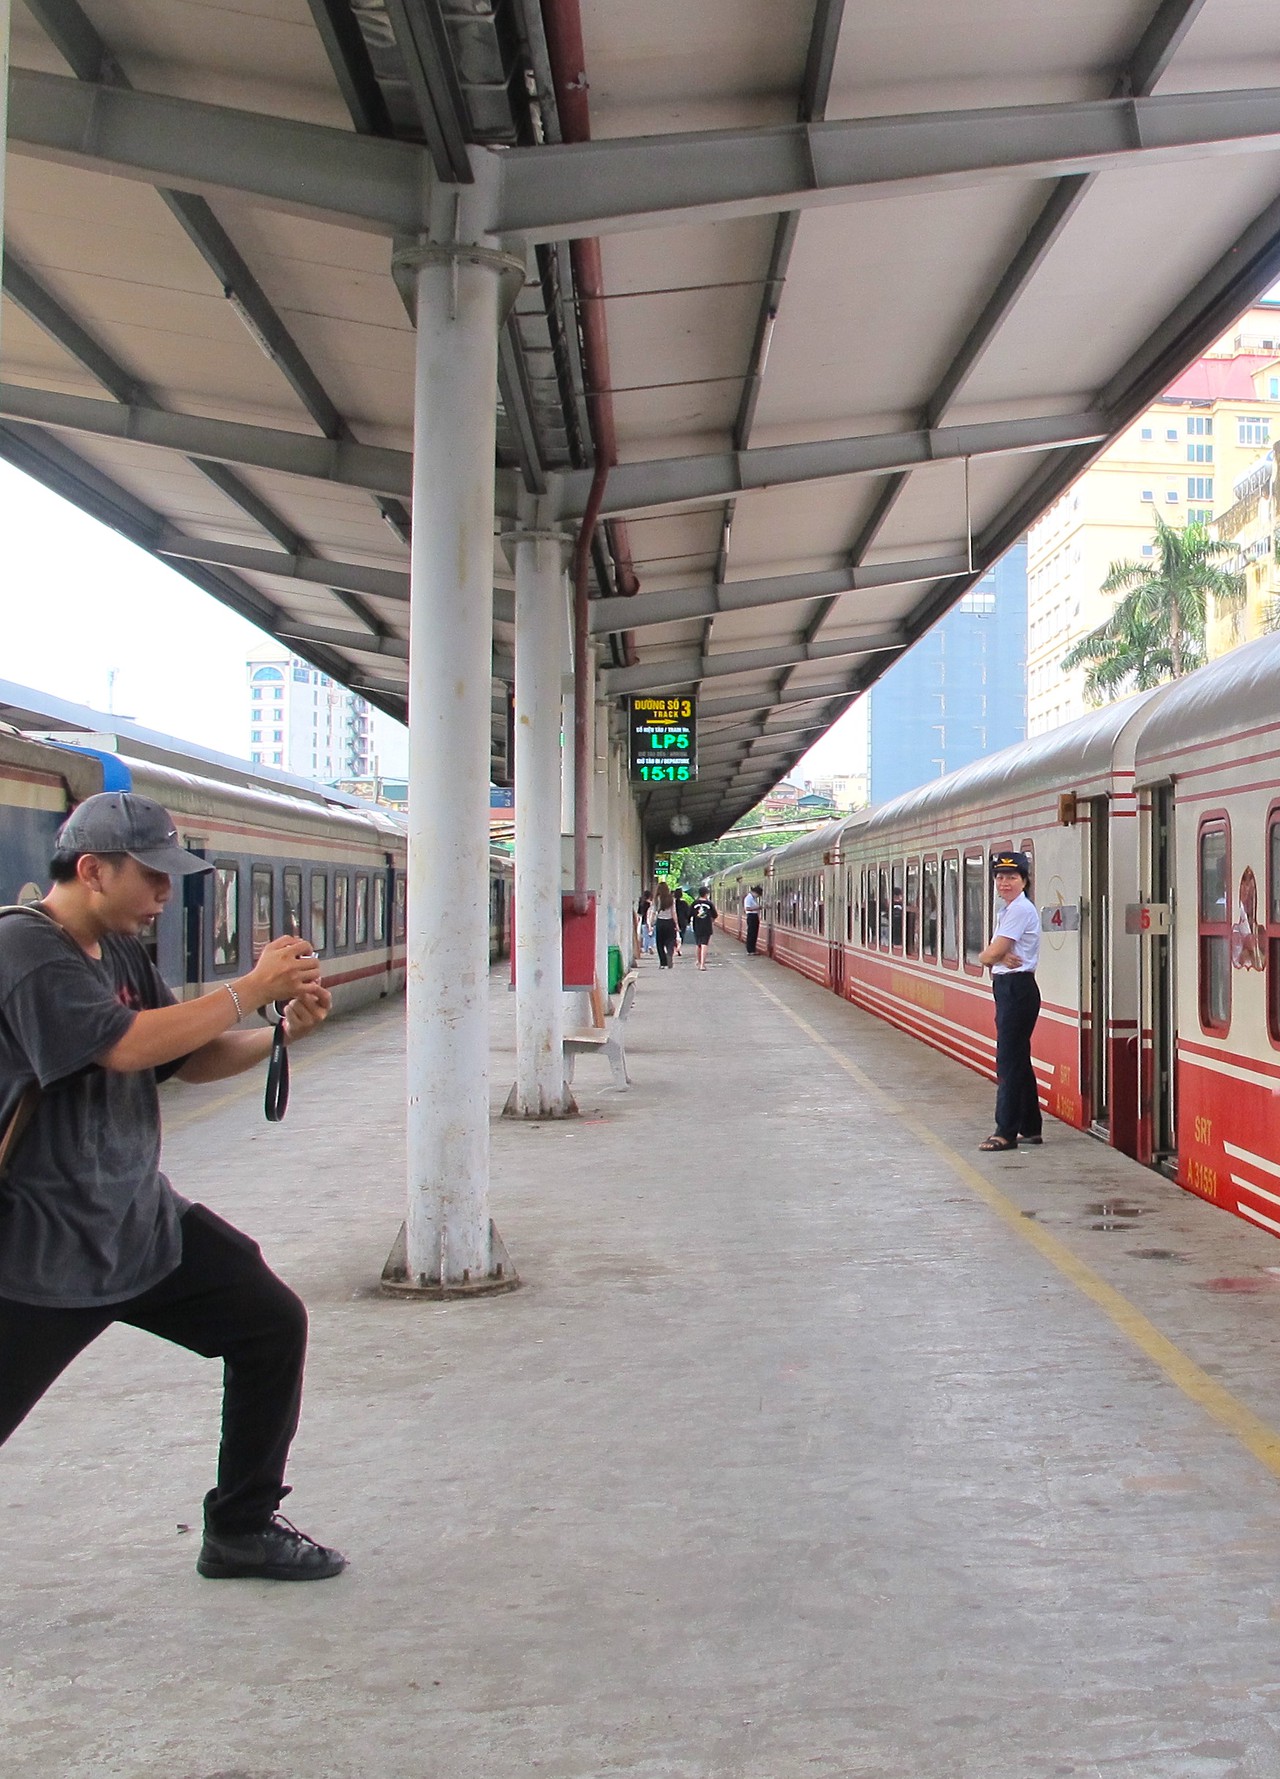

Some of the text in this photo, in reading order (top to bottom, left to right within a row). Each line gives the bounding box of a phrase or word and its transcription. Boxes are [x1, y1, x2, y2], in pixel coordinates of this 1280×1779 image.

[667, 697, 680, 710] SỐ
[681, 700, 691, 717] 3
[651, 734, 689, 749] LP5
[640, 766, 689, 781] 15:15
[1051, 909, 1063, 927] 4
[1140, 908, 1151, 929] 5
[1194, 1115, 1212, 1146] SRT
[1187, 1158, 1217, 1198] A 31551
